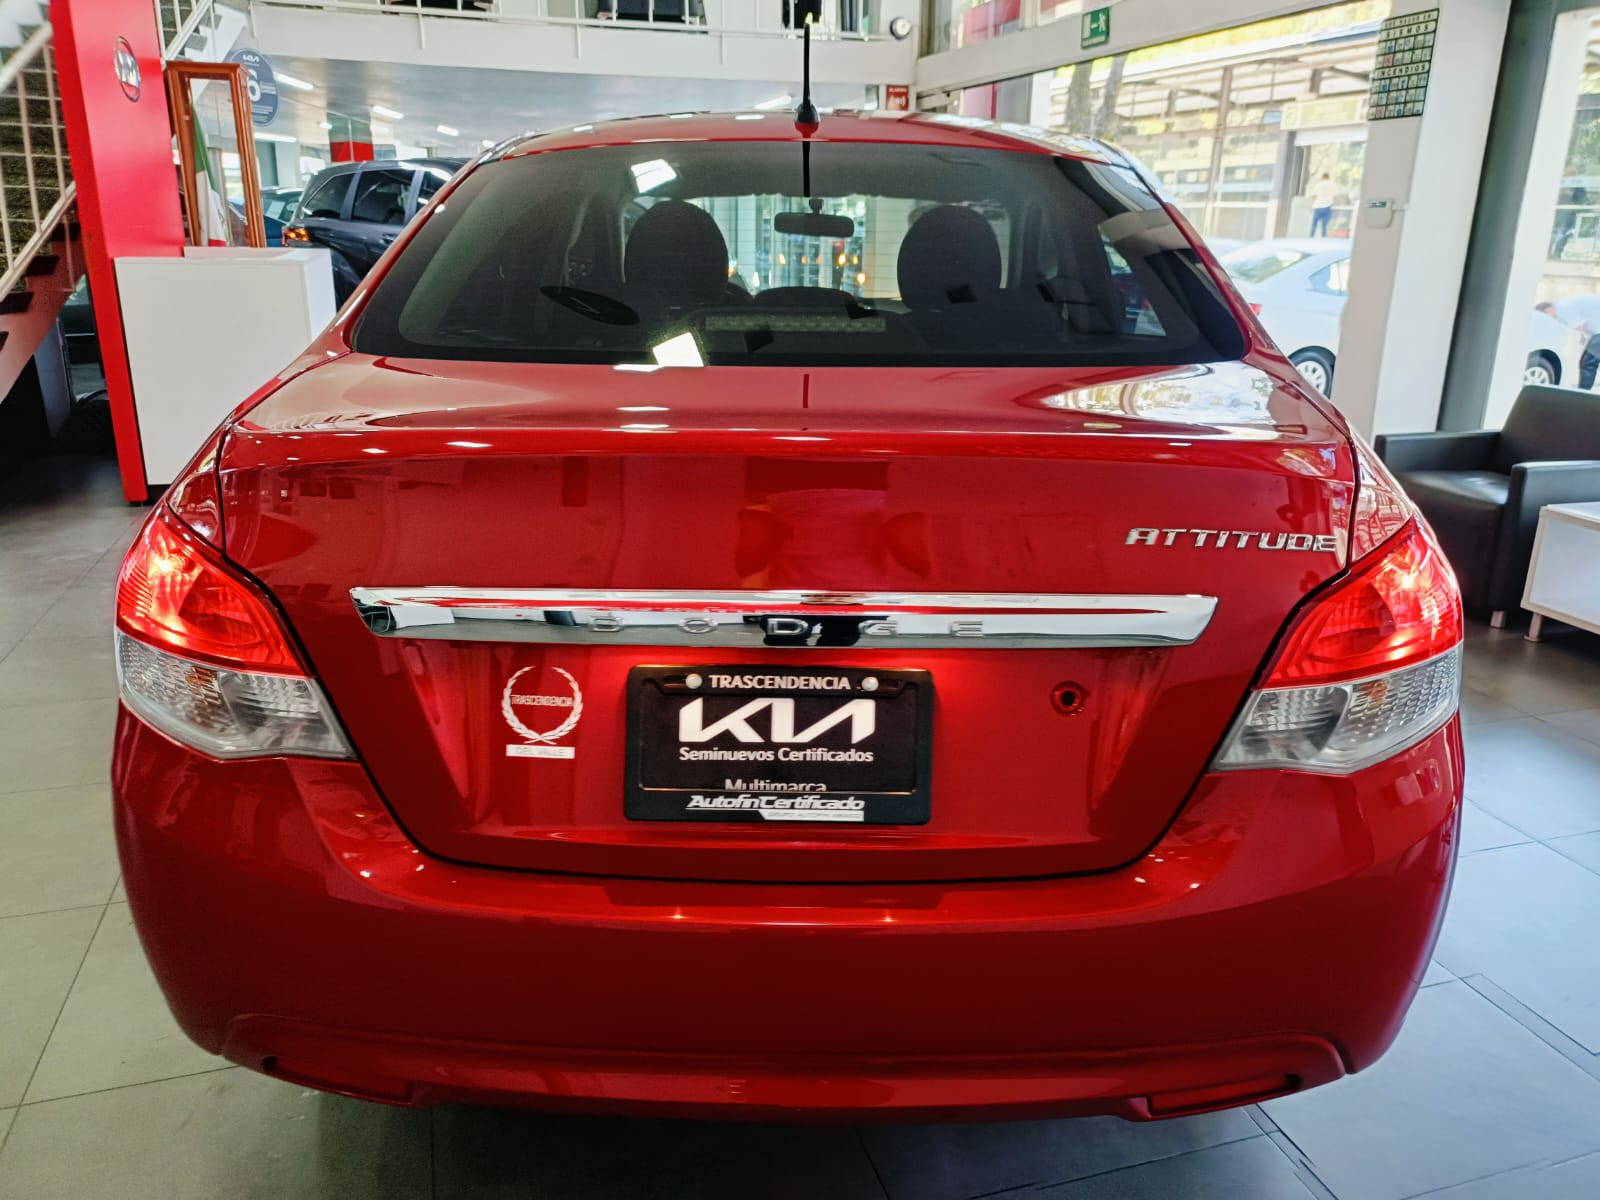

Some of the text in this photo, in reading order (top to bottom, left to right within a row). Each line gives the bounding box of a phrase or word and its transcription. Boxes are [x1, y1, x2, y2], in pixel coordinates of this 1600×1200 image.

[1386, 24, 1429, 38] SISMOS
[1377, 64, 1426, 77] INCENDIOS
[1124, 527, 1339, 553] ATTITUDE
[587, 614, 985, 638] DODGE
[708, 674, 852, 691] TRASCENDENCIA
[678, 697, 877, 744] KIA
[678, 746, 875, 763] Seminuevos Certificados
[724, 779, 827, 792] Multimarca
